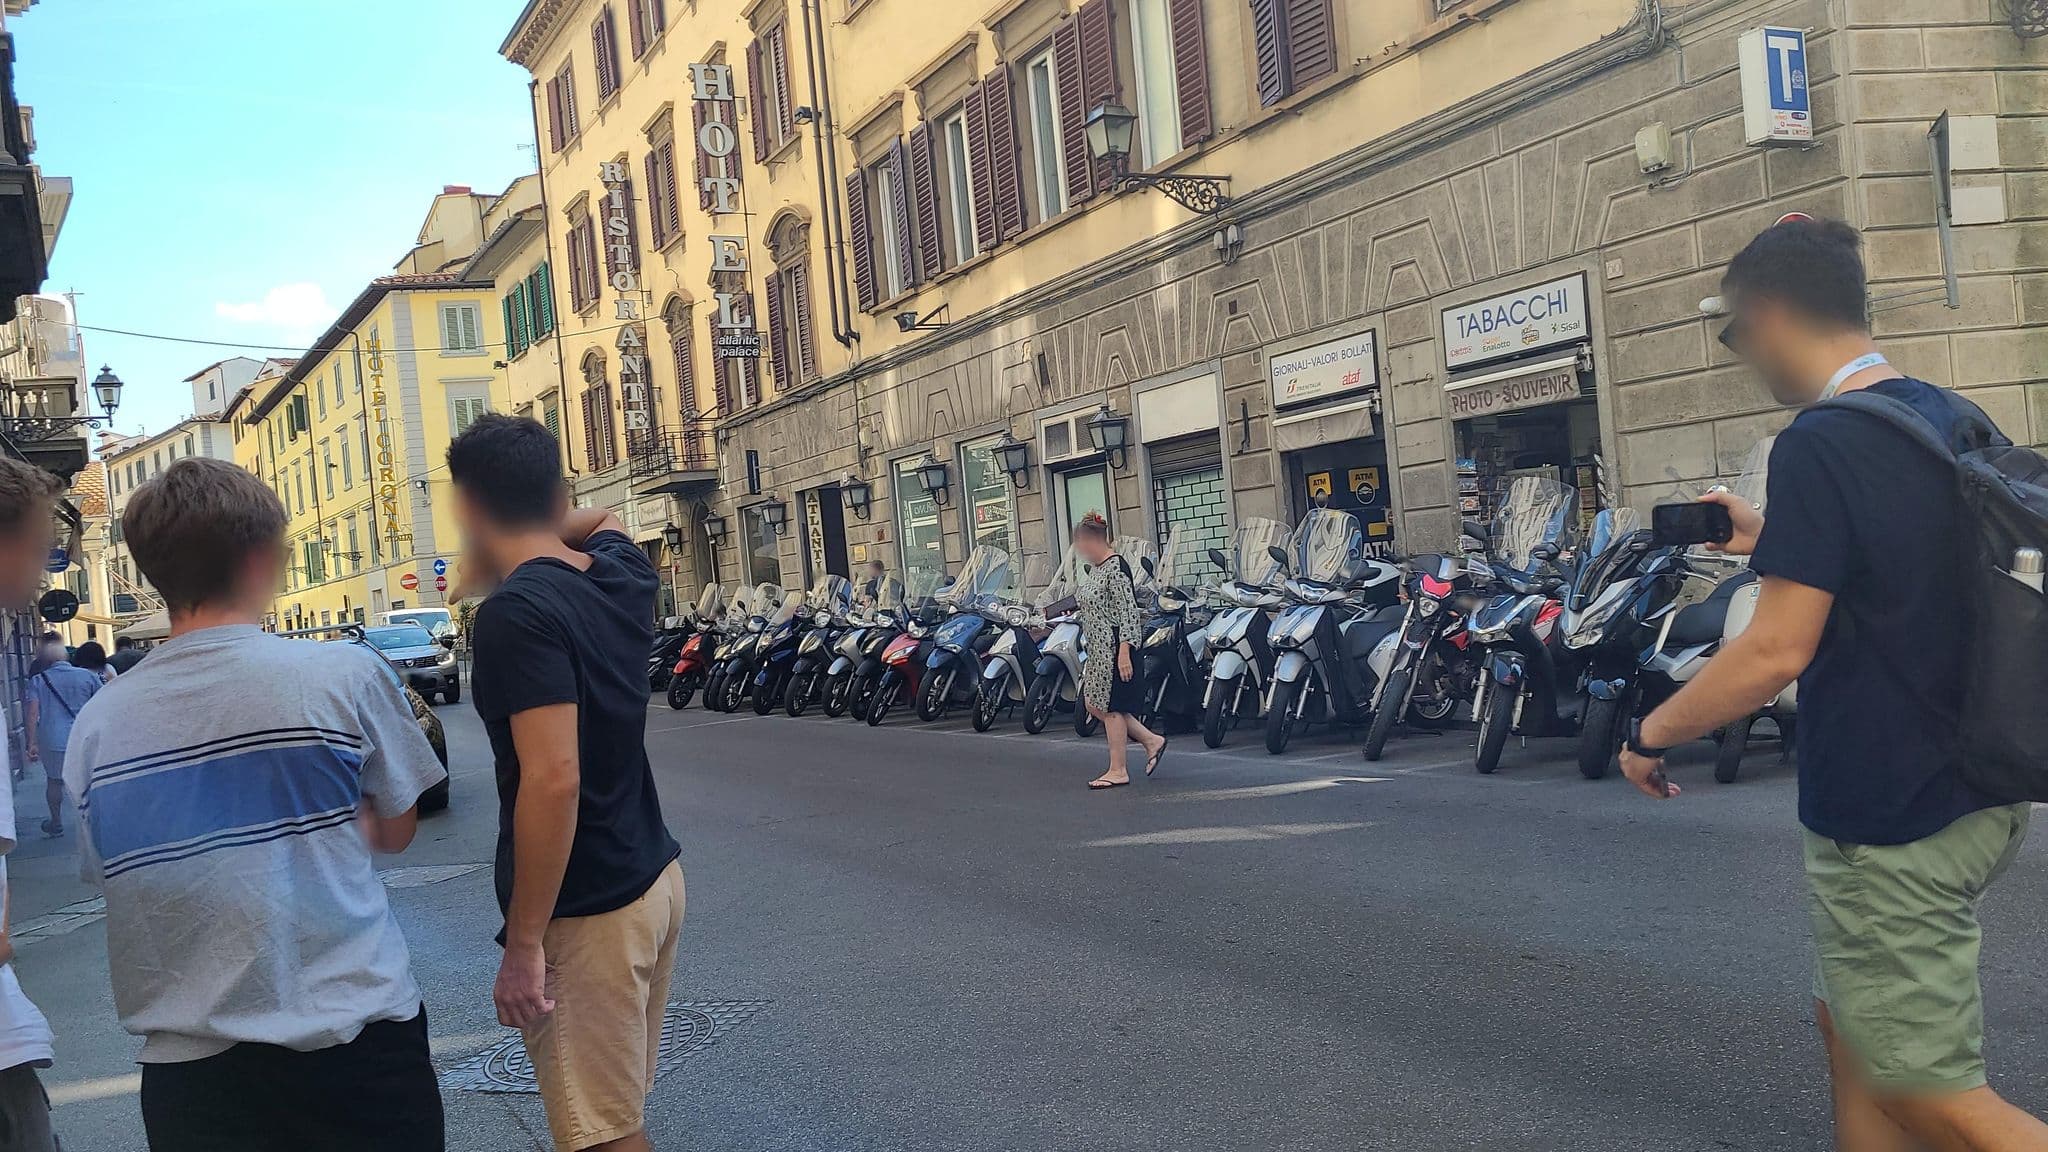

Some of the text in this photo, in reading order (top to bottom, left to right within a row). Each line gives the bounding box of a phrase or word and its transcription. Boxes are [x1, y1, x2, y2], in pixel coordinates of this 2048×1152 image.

[1768, 36, 1799, 103] T
[688, 63, 752, 329] HOTEL
[600, 162, 652, 430] RISTORANTE
[1457, 288, 1568, 339] TABACCHI
[1560, 320, 1580, 333] Sisal
[718, 335, 760, 346] atlantic
[720, 347, 760, 357] palace
[1341, 342, 1372, 360] BOLLATI
[1342, 368, 1361, 386] ataf
[1451, 389, 1493, 413] PHOTO
[1502, 373, 1574, 404] SOUVENIR
[376, 433, 400, 533] CORONA
[1313, 478, 1326, 486] ATM
[1355, 472, 1374, 481] ATM
